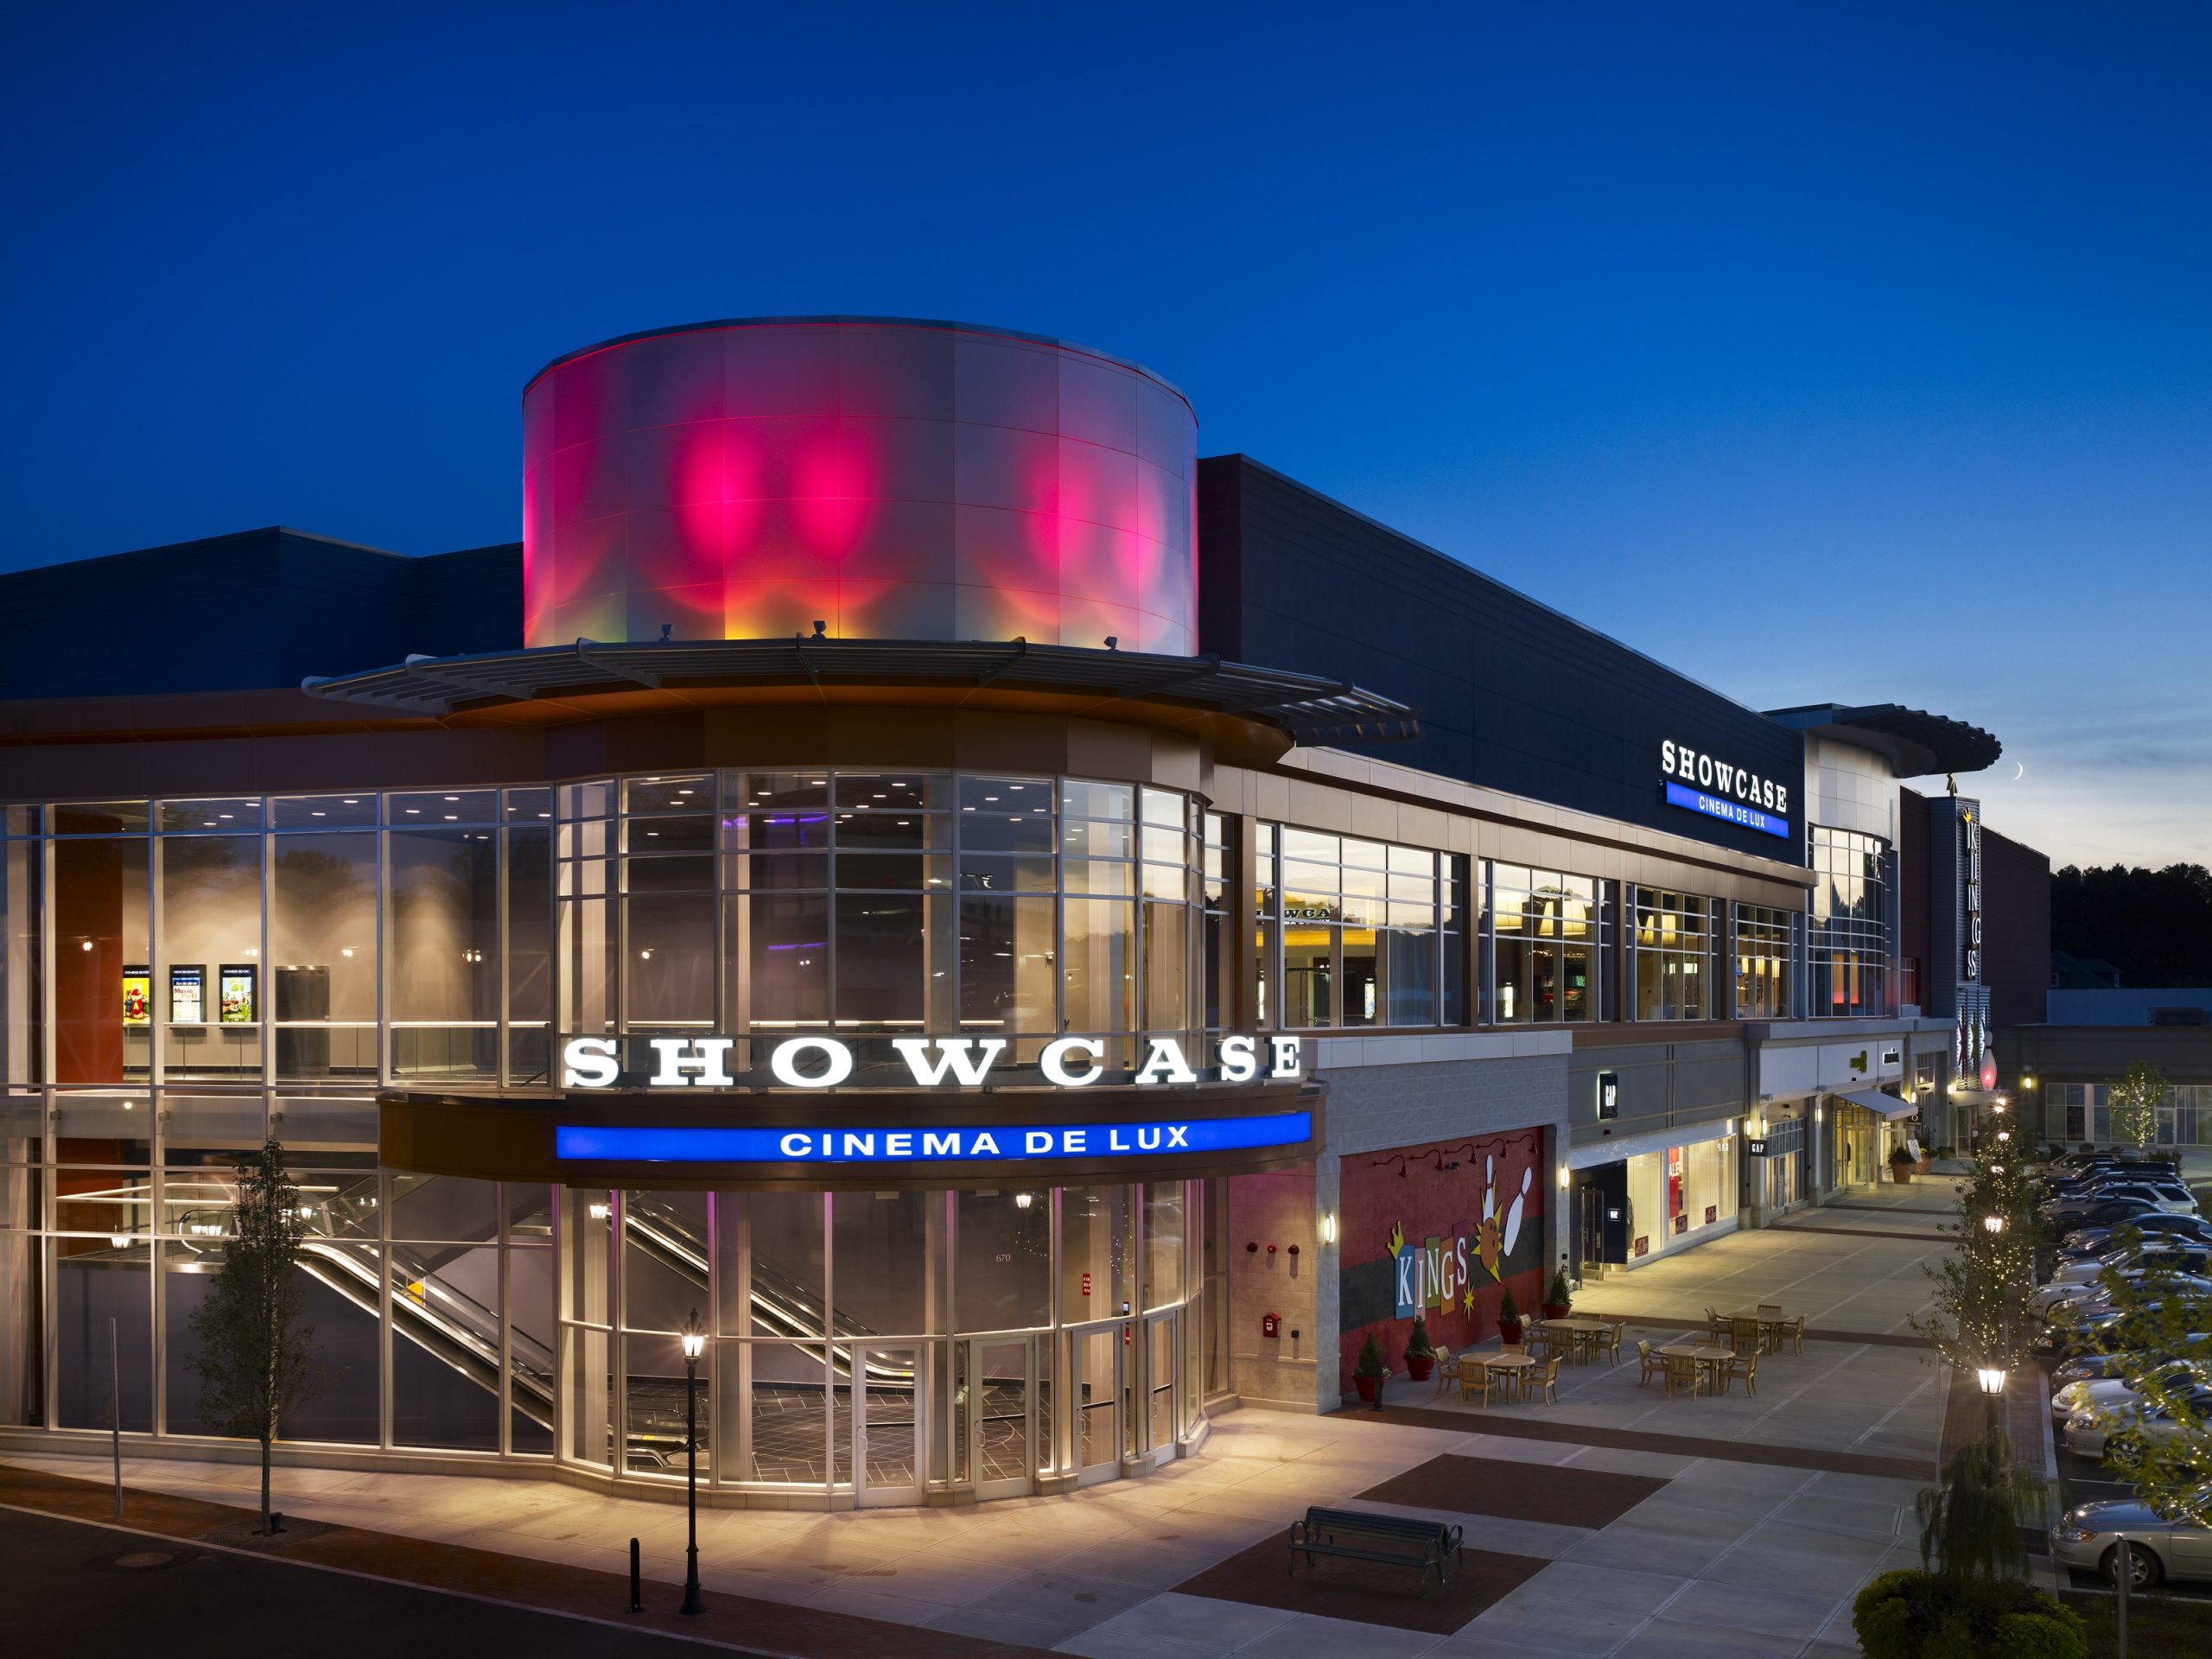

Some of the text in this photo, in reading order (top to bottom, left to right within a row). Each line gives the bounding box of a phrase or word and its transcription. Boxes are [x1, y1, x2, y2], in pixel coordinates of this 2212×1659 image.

[1662, 740, 1787, 813] SHOWCASE
[1699, 796, 1765, 829] CINEMA DE LUX
[1967, 823, 1980, 976] KINGS
[564, 1036, 1300, 1088] SHOWCASE
[780, 1126, 1189, 1157] CINEMA DE LUX
[1751, 1143, 1764, 1153] GAP
[1669, 1162, 1680, 1176] ALE
[995, 1253, 1011, 1262] 670
[1398, 1236, 1467, 1309] KINGS
